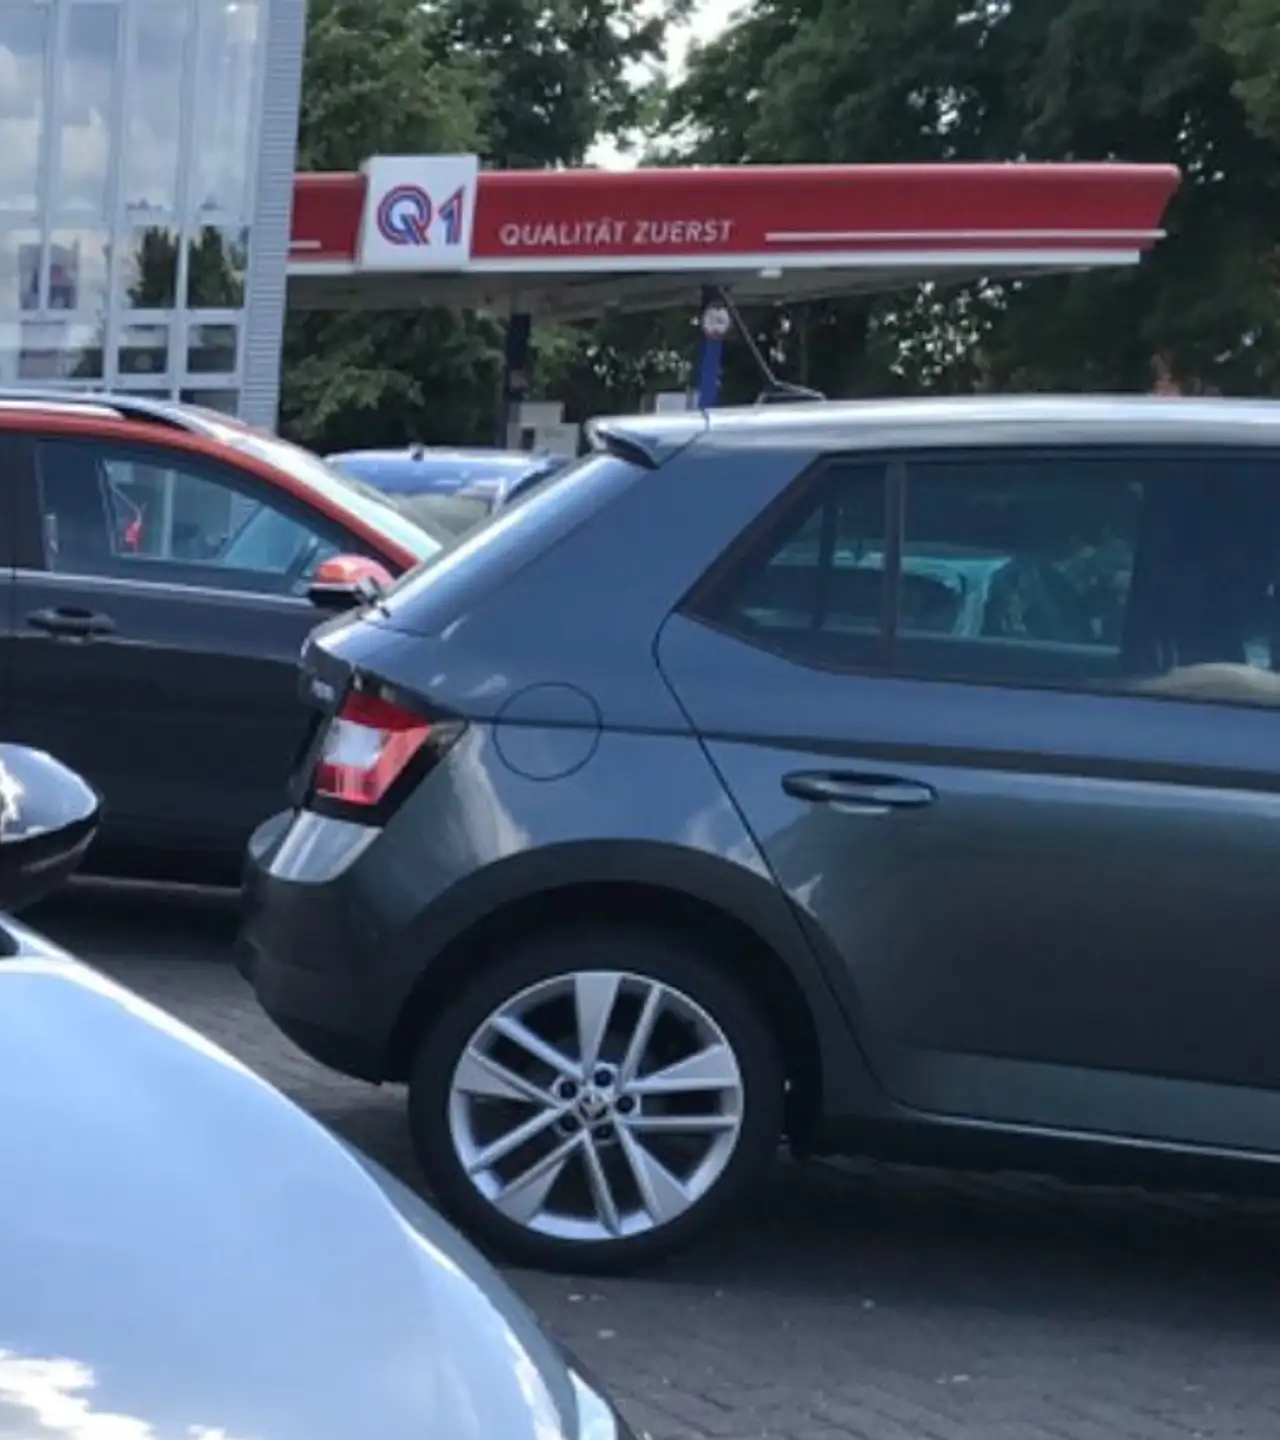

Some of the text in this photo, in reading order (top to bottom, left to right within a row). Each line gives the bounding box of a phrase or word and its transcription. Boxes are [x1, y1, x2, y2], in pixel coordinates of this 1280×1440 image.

[376, 184, 466, 247] Q1
[499, 217, 733, 247] QUALITÄT ZUERST
